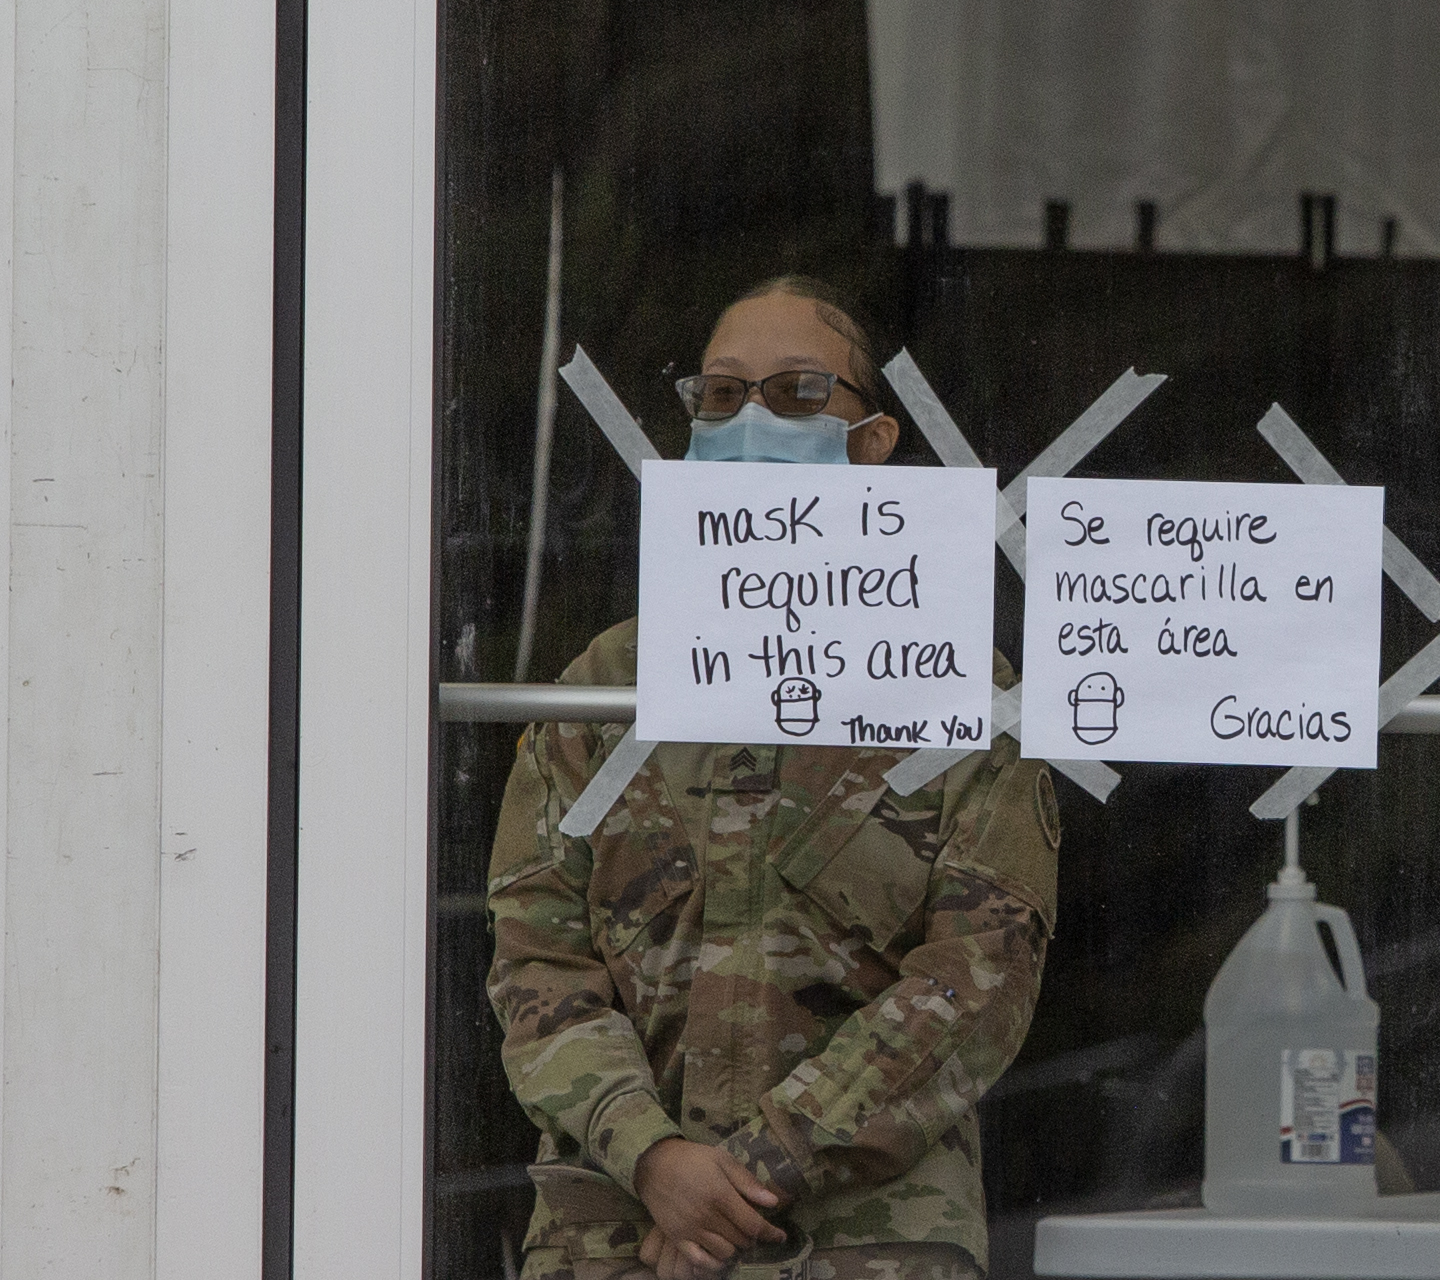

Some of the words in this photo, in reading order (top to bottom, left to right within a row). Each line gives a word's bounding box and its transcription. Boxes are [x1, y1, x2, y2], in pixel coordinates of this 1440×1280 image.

[861, 486, 905, 536] is
[1060, 500, 1110, 547] Se
[1147, 510, 1278, 563] require
[721, 554, 920, 633] required
[1056, 558, 1267, 604] mascarilla
[1295, 575, 1333, 603] en
[691, 636, 731, 685] in
[748, 630, 847, 678] this
[867, 640, 967, 680] area
[1058, 618, 1129, 657] esta
[1157, 617, 1238, 658] área
[1210, 695, 1351, 743] Gracias
